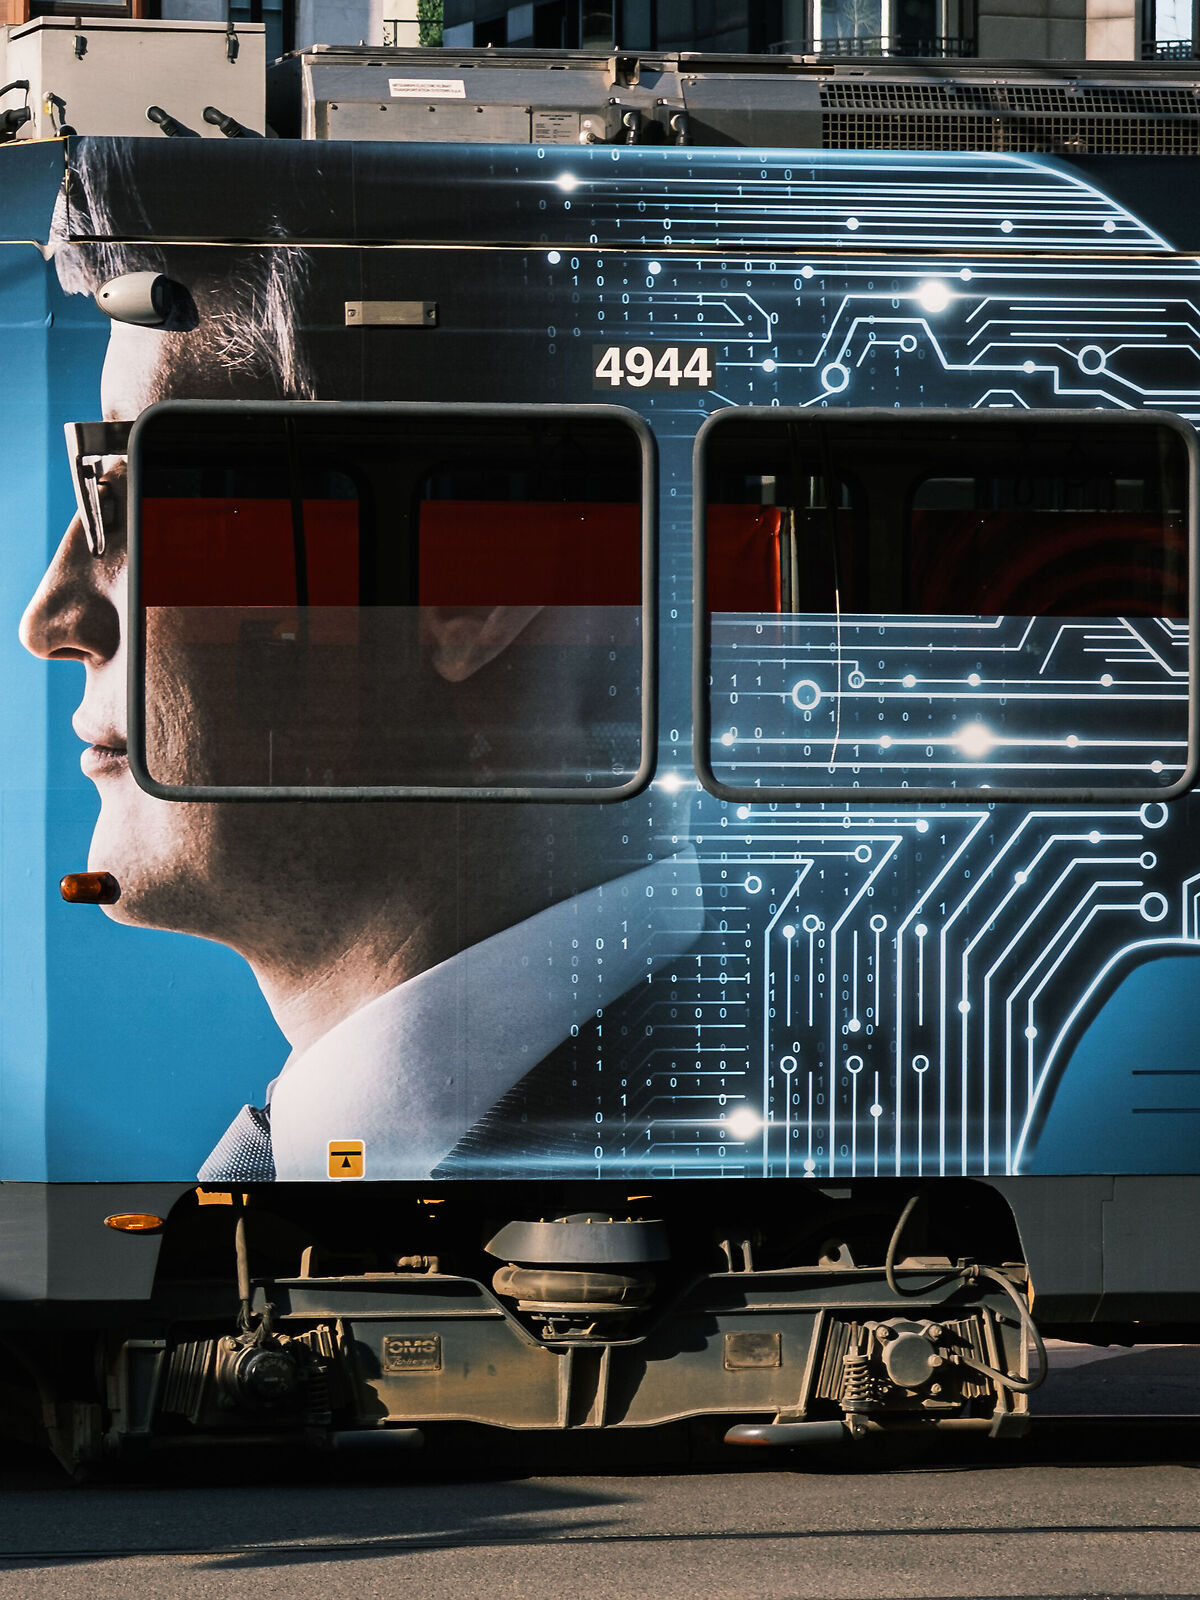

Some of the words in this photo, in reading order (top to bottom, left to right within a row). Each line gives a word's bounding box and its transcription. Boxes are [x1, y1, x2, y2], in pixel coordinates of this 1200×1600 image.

[537, 148, 546, 158] 0
[611, 149, 620, 160] 0
[784, 170, 792, 180] 0
[564, 200, 571, 210] 0
[664, 218, 671, 229] 0
[590, 234, 598, 244] 0
[570, 257, 580, 270] 0
[745, 262, 752, 271] 0
[770, 262, 776, 271] 0
[596, 276, 604, 286] 0
[646, 276, 654, 288] 0
[794, 278, 802, 290] 0
[622, 293, 630, 304] 0
[598, 311, 604, 320] 0
[697, 312, 704, 322] 0
[771, 312, 779, 324] 0
[869, 332, 876, 341] 0
[595, 346, 712, 387] 4944
[670, 609, 678, 618] 0
[756, 625, 762, 634] 0
[878, 660, 884, 669] 0
[730, 692, 738, 704] 0
[804, 710, 812, 722] 0
[902, 712, 908, 721] 0
[670, 729, 678, 742] 0
[730, 727, 738, 738] 0
[755, 728, 762, 738] 0
[804, 746, 811, 756] 0
[926, 746, 933, 756] 0
[721, 818, 727, 827] 0
[843, 817, 851, 828] 0
[622, 835, 628, 844] 0
[696, 887, 702, 896] 0
[720, 886, 727, 897] 0
[868, 887, 874, 896] 0
[769, 904, 776, 914] 0
[720, 920, 727, 932] 0
[596, 938, 604, 950] 0
[818, 939, 825, 948] 0
[720, 956, 726, 965] 0
[572, 974, 578, 983] 0
[720, 972, 727, 984] 0
[818, 973, 824, 983] 0
[842, 990, 849, 1000] 0
[596, 1009, 602, 1018] 0
[695, 1008, 702, 1018] 0
[720, 1008, 726, 1018] 0
[769, 1008, 775, 1017] 0
[866, 1008, 874, 1018] 0
[570, 1024, 578, 1037] 0
[842, 1024, 848, 1035] 0
[866, 1024, 874, 1035] 0
[792, 1042, 800, 1053] 0
[720, 1060, 726, 1069] 0
[670, 1078, 677, 1088] 0
[719, 1094, 726, 1105] 0
[792, 1094, 800, 1104] 0
[596, 1112, 602, 1123] 0
[594, 1146, 602, 1158] 0
[718, 1146, 726, 1156] 0
